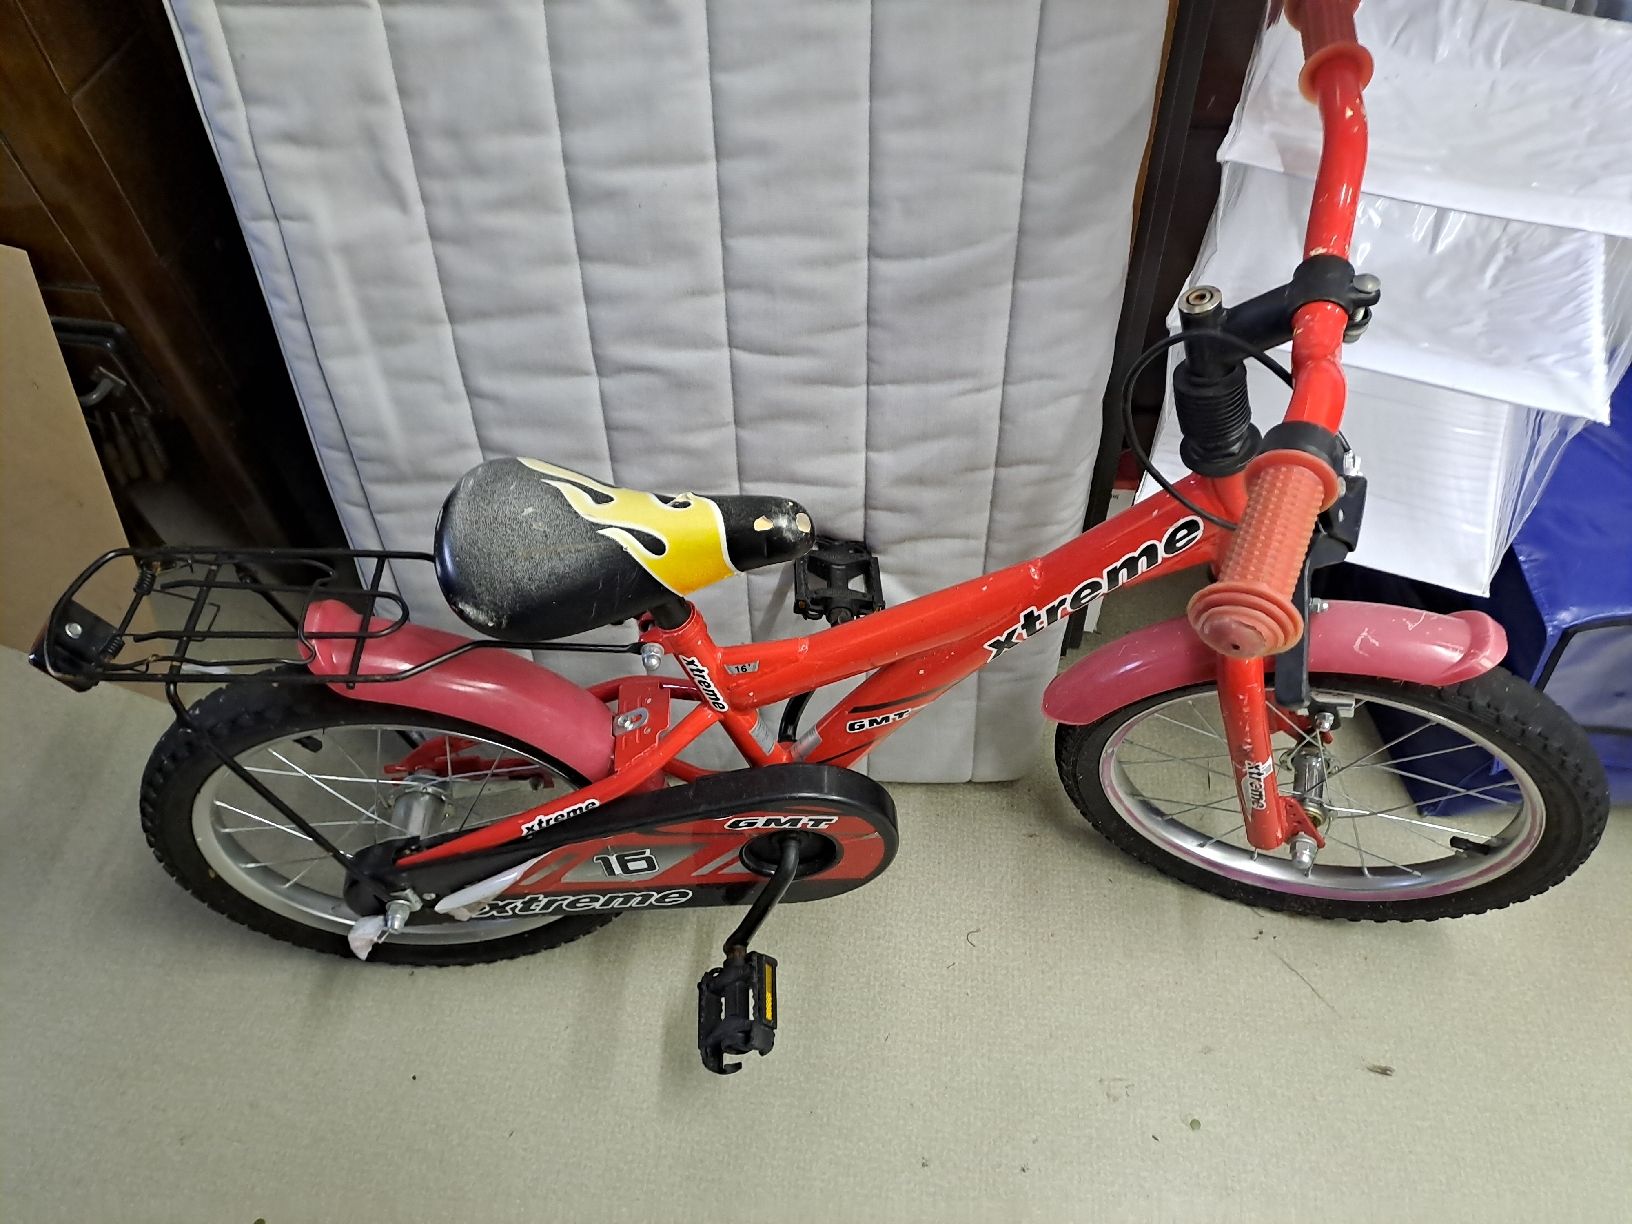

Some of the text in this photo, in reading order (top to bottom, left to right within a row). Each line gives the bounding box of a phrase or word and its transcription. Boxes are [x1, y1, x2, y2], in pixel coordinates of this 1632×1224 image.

[984, 515, 1204, 662] xtreme
[680, 655, 728, 711] xtreme
[846, 708, 911, 733] GMT
[1245, 761, 1266, 809] xtreme
[521, 799, 600, 837] xtreme
[724, 816, 838, 830] GMT
[593, 849, 660, 877] 16
[472, 889, 692, 918] xtreme
